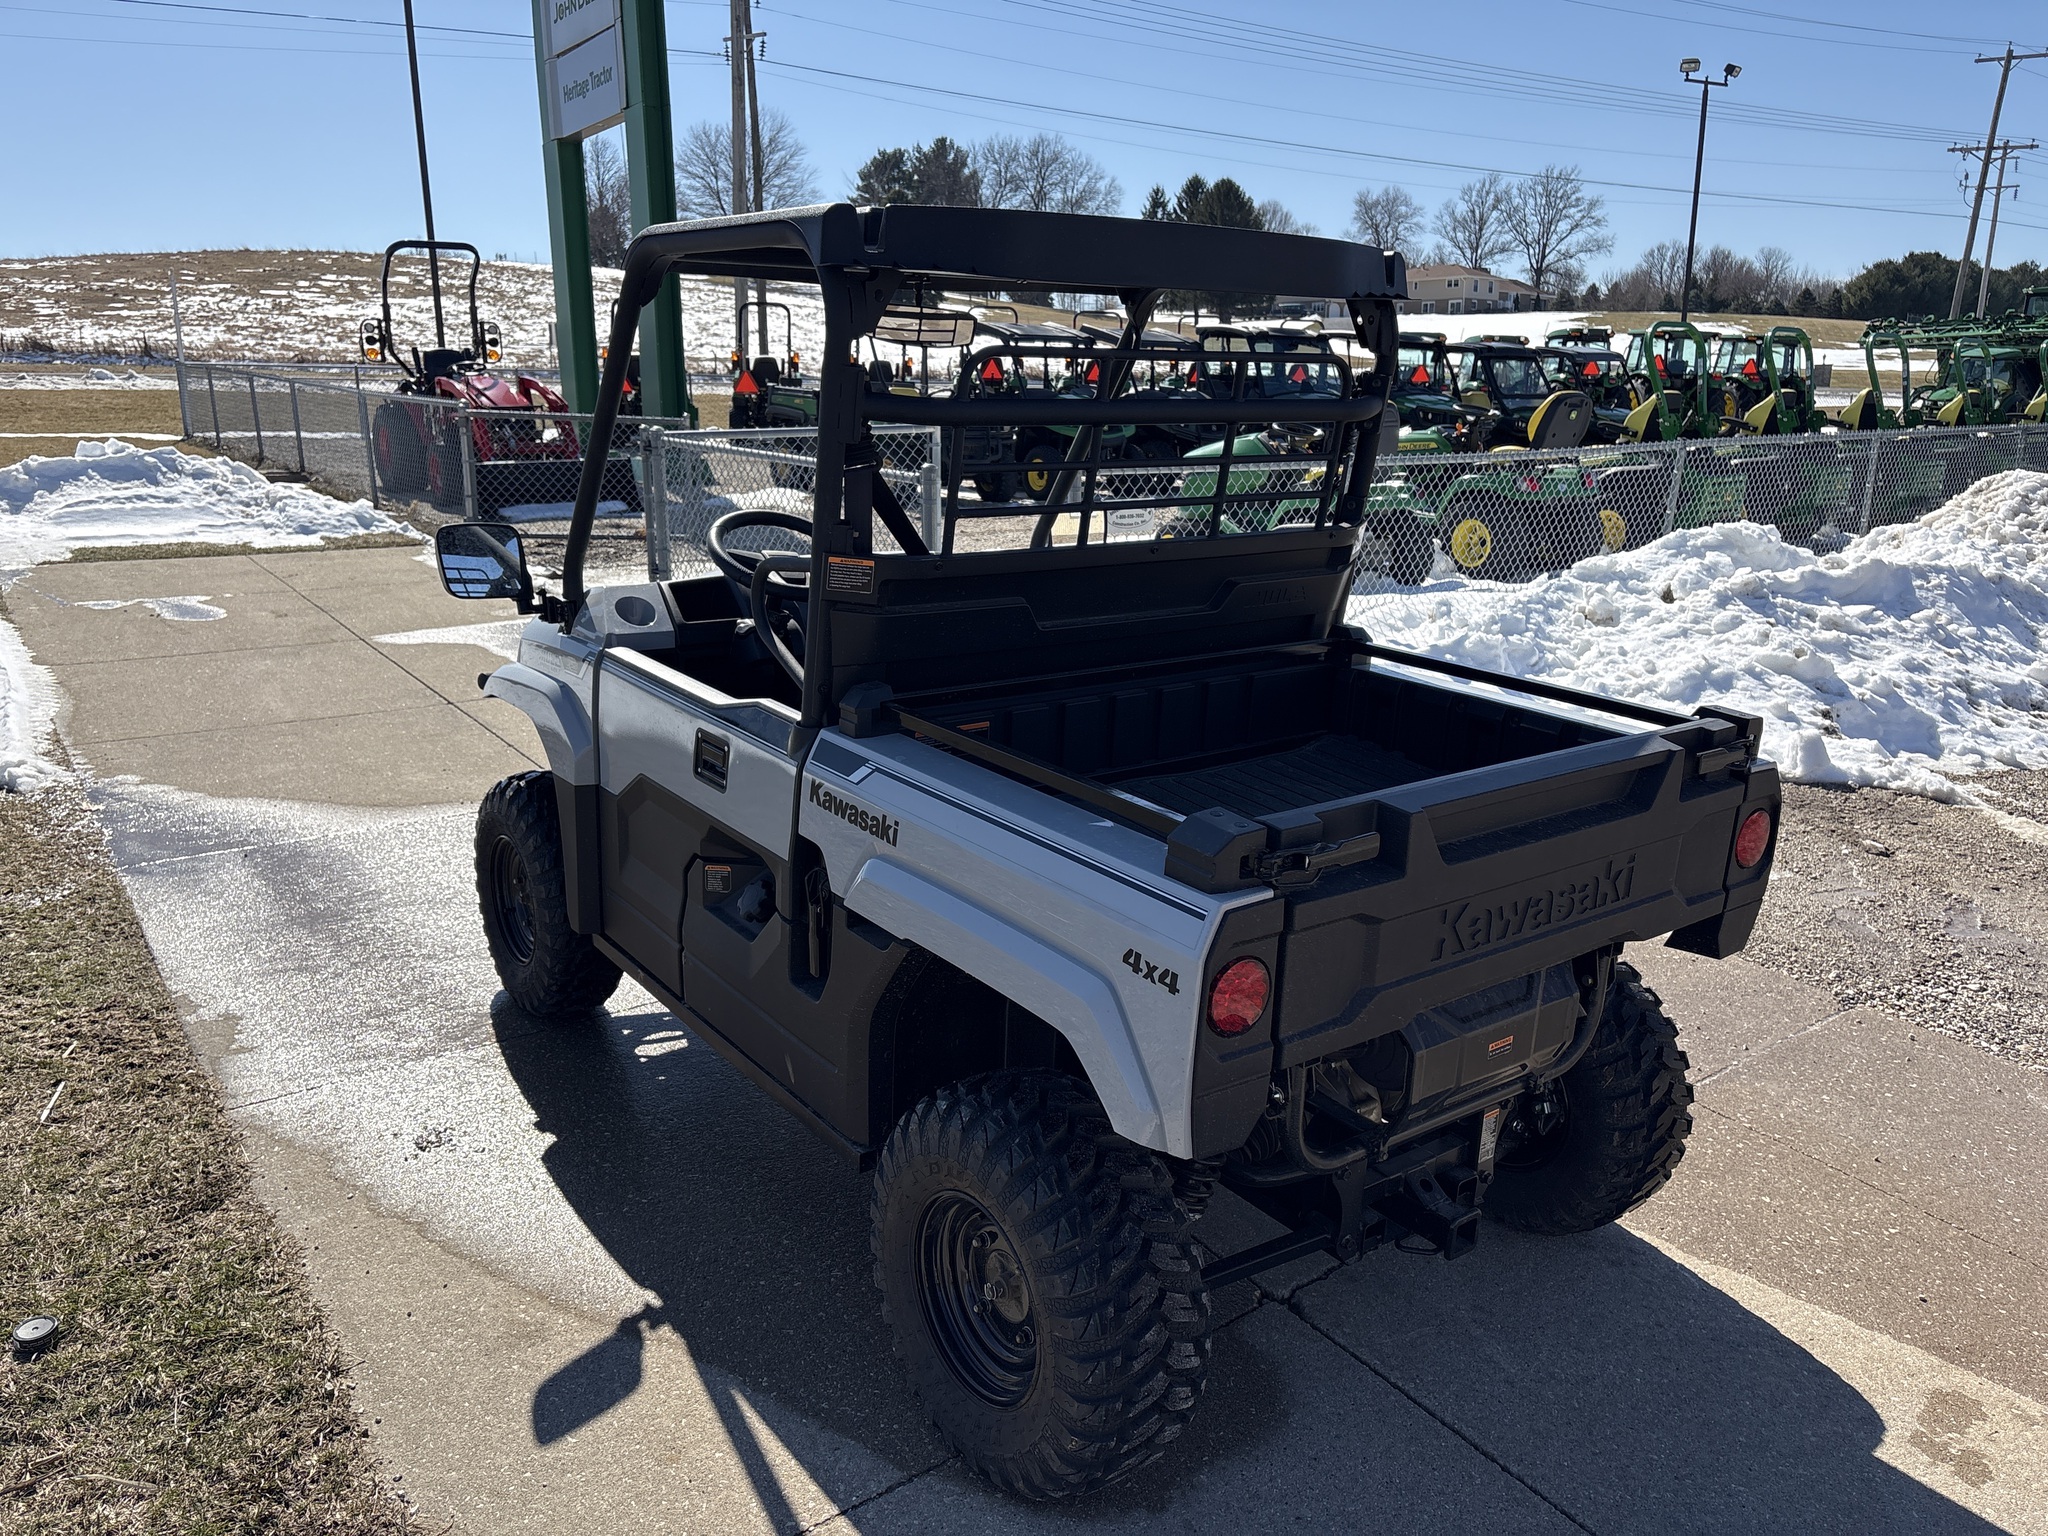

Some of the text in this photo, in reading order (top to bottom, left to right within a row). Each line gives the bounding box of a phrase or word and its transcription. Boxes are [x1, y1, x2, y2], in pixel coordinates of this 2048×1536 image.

[553, 0, 578, 24] JOHN
[563, 66, 613, 103] Heritage Tractor
[809, 778, 899, 847] Kawasaki
[1431, 853, 1638, 962] Kawasaki
[1122, 948, 1180, 996] 4x4
